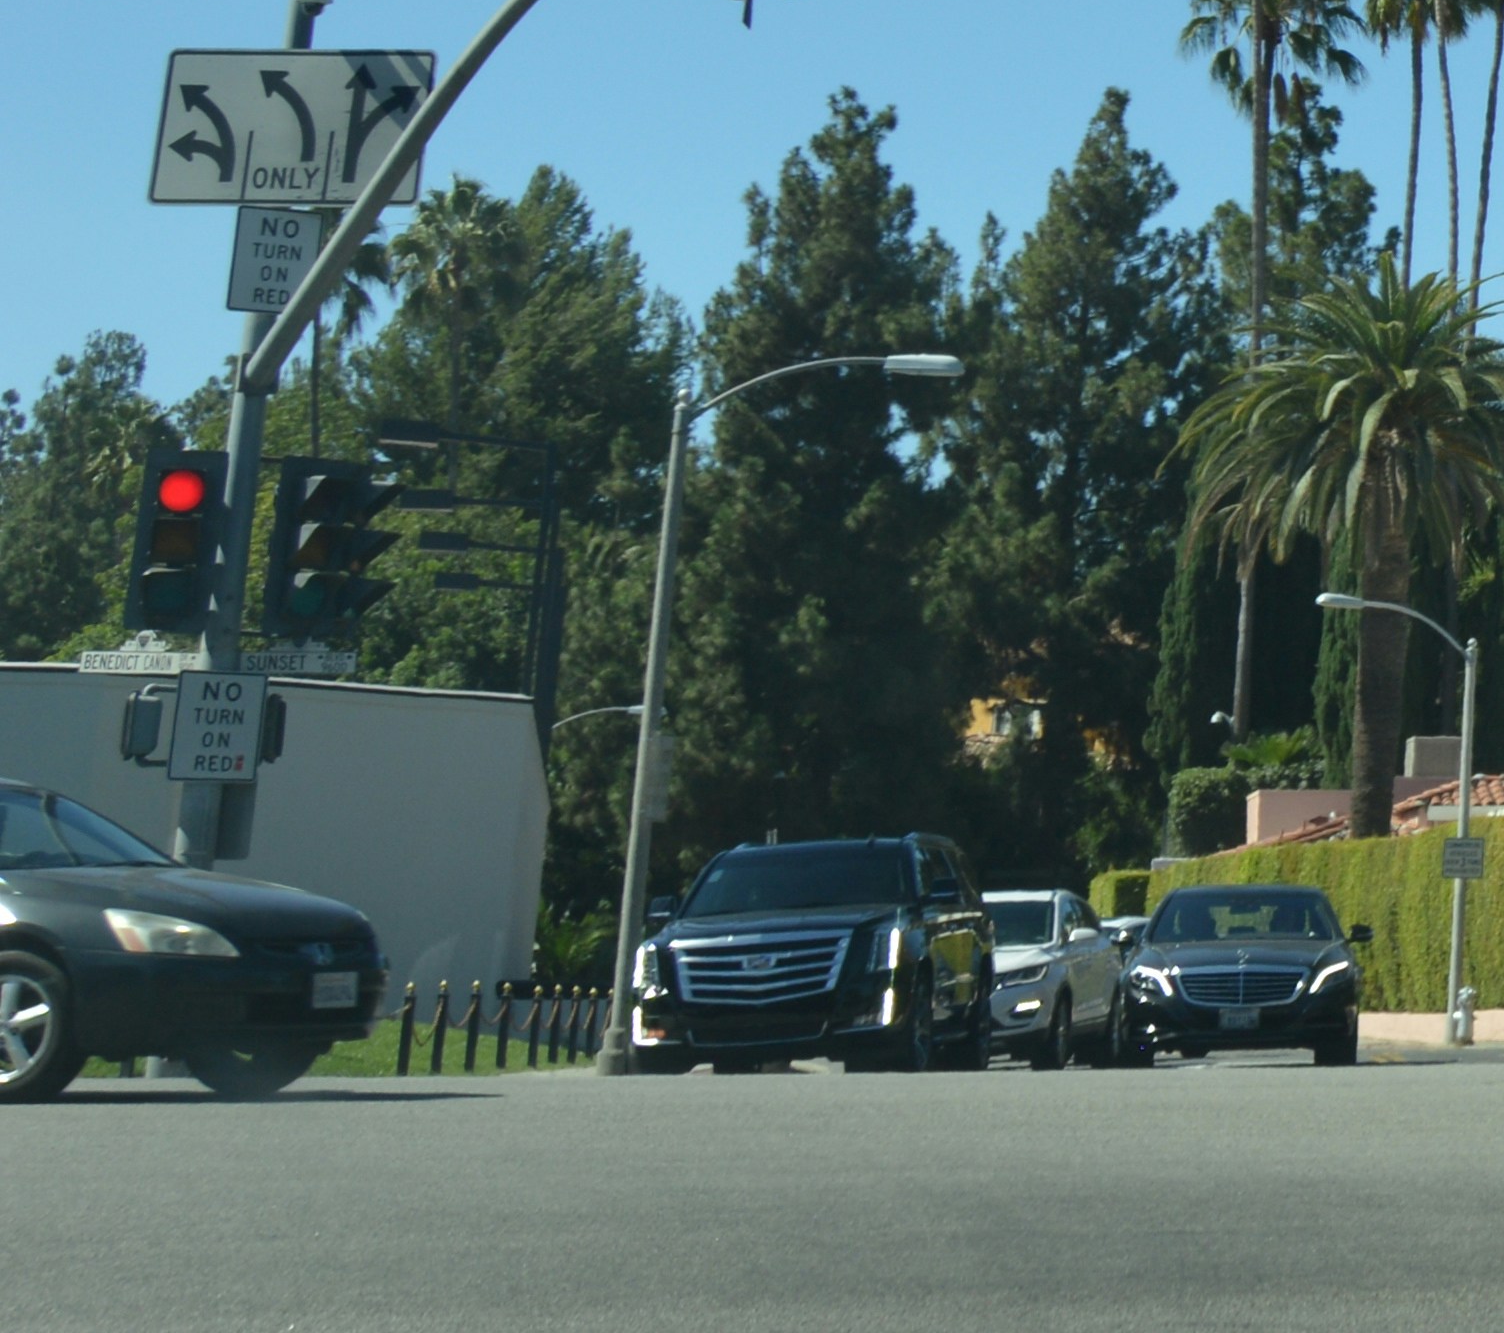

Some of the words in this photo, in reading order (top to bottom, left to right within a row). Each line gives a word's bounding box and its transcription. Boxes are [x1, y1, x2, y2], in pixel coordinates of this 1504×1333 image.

[252, 167, 320, 189] ONLY
[260, 217, 300, 239] NO
[253, 242, 303, 261] TURN
[260, 265, 289, 282] ON
[252, 287, 291, 305] RED
[84, 653, 142, 671] BENEDICT
[143, 654, 172, 671] CANON
[246, 655, 306, 671] SUNSET
[202, 682, 243, 702] NO
[194, 708, 245, 725] TURN
[201, 731, 231, 748] ON
[193, 755, 233, 773] RED
